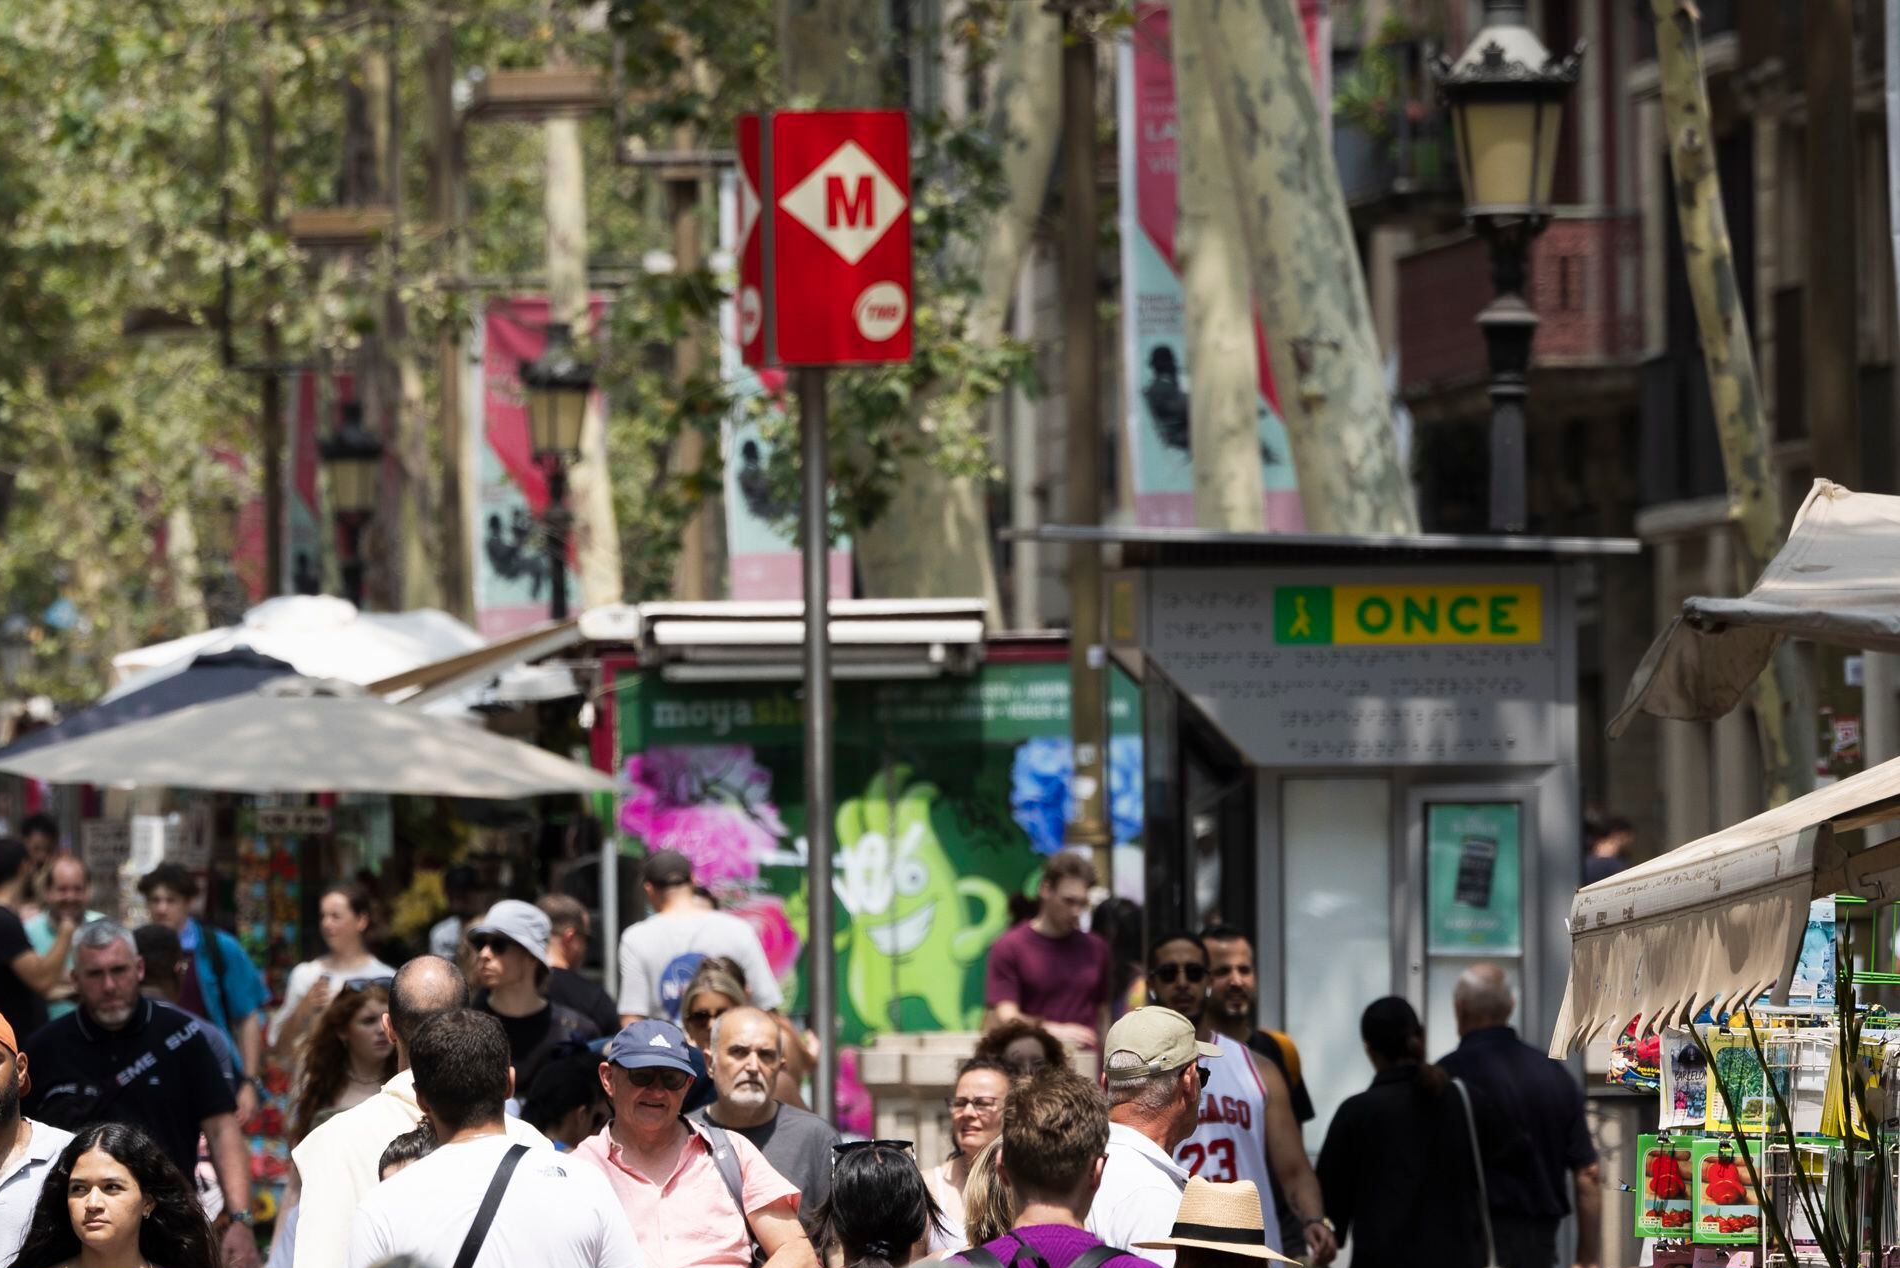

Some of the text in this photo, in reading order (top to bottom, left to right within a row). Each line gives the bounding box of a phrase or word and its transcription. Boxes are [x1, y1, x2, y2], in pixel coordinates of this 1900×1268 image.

[826, 175, 875, 229] M
[1356, 596, 1519, 635] ONCE
[652, 690, 838, 736] moyash
[1178, 1138, 1238, 1183] 23
